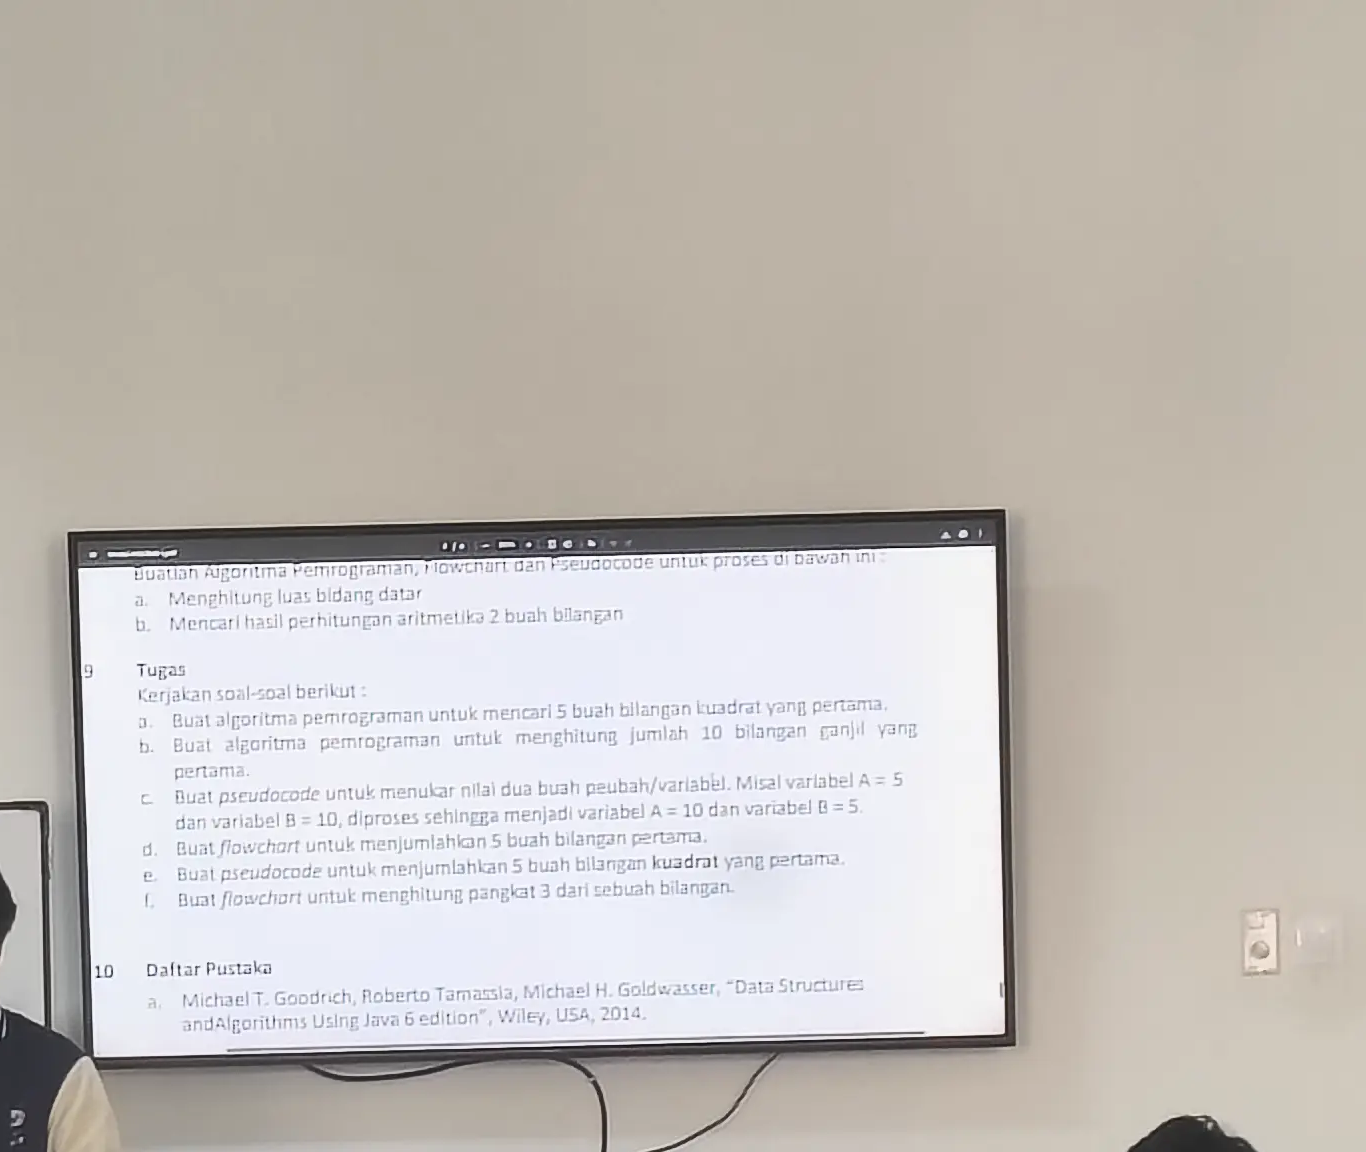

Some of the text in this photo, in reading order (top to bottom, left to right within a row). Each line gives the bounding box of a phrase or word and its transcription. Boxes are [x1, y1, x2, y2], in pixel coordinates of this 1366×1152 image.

[169, 589, 273, 609] Menghitung
[277, 588, 311, 604] luas
[316, 586, 374, 606] bidang
[378, 585, 422, 601] datar
[169, 614, 239, 631] Mencari
[245, 613, 283, 630] hasil
[288, 611, 392, 632] perhitungan
[397, 608, 484, 626] aritmetika
[504, 606, 547, 624] buah
[553, 606, 623, 625] bilangan
[136, 662, 186, 681] Tugas
[138, 686, 212, 706] Kerjakan
[216, 683, 291, 701] soal-soal
[295, 682, 356, 699] berikut
[172, 713, 211, 728] Buat
[216, 711, 297, 730] algoritma
[302, 710, 424, 729] pemrograman
[428, 705, 478, 722] untuk
[483, 703, 551, 721] mencari
[572, 702, 614, 719] buah
[619, 701, 691, 720] bilangan
[696, 698, 761, 715] kuadrat
[766, 701, 807, 717] yang
[812, 699, 887, 715] pertama.
[173, 737, 211, 753] Buat
[225, 735, 306, 755] algoritma
[320, 735, 440, 753] pemrograman
[453, 729, 502, 747] untuk
[515, 727, 618, 748] menghitung
[629, 724, 688, 746] jumlah
[735, 723, 806, 742] bilangan
[819, 720, 865, 741] ganjil
[877, 723, 918, 739] yang
[174, 765, 249, 781] pertama.
[174, 789, 213, 804] Buat
[218, 786, 320, 808] pseudocode
[325, 783, 375, 801] untuk
[380, 782, 455, 800] menukar
[461, 781, 496, 798] nilai
[500, 780, 532, 797] dua
[538, 779, 580, 796] buah
[585, 773, 731, 797] peubah/variabel.
[736, 774, 781, 791] Misal
[785, 771, 853, 790] variabel
[175, 814, 206, 830] dan
[211, 811, 280, 829] variabel
[347, 809, 419, 830] diproses
[424, 807, 499, 827] sehingga
[504, 805, 572, 825] menjadi
[577, 803, 645, 820] variabel
[708, 800, 740, 817] dan
[744, 799, 812, 816] variabel
[176, 841, 215, 856] Buat
[219, 838, 301, 859] flowchart
[305, 836, 355, 853] untuk
[360, 833, 487, 854] menjumlahkan
[507, 831, 550, 848] buah
[554, 830, 626, 849] bilangan
[631, 831, 707, 847] pertama.
[177, 866, 215, 882] Buat
[220, 862, 322, 884] pseudocode
[327, 861, 377, 878] untuk
[381, 858, 508, 880] menjumlahkan
[528, 857, 570, 873] buah
[575, 855, 646, 875] bilangan
[652, 852, 718, 870] kuadrat
[724, 855, 764, 871] yang
[769, 853, 845, 869] pertama.
[178, 892, 215, 907] Buat
[219, 889, 302, 910] flowchart
[307, 887, 356, 904] untuk
[361, 885, 463, 906] menghitung
[468, 883, 536, 904] pangkat
[556, 881, 589, 898] dari
[594, 879, 655, 897] sebuah
[660, 879, 734, 898] bilangan.
[146, 959, 272, 977] Daftar Pustaka
[182, 990, 249, 1008] Michael
[362, 987, 430, 1004] Roberto
[523, 981, 590, 999] Michael
[778, 978, 863, 993] Structures
[182, 1014, 307, 1035] andAlgorithms
[312, 1013, 359, 1032] Using
[363, 1012, 399, 1027] Java
[599, 1005, 646, 1021] 2014.
